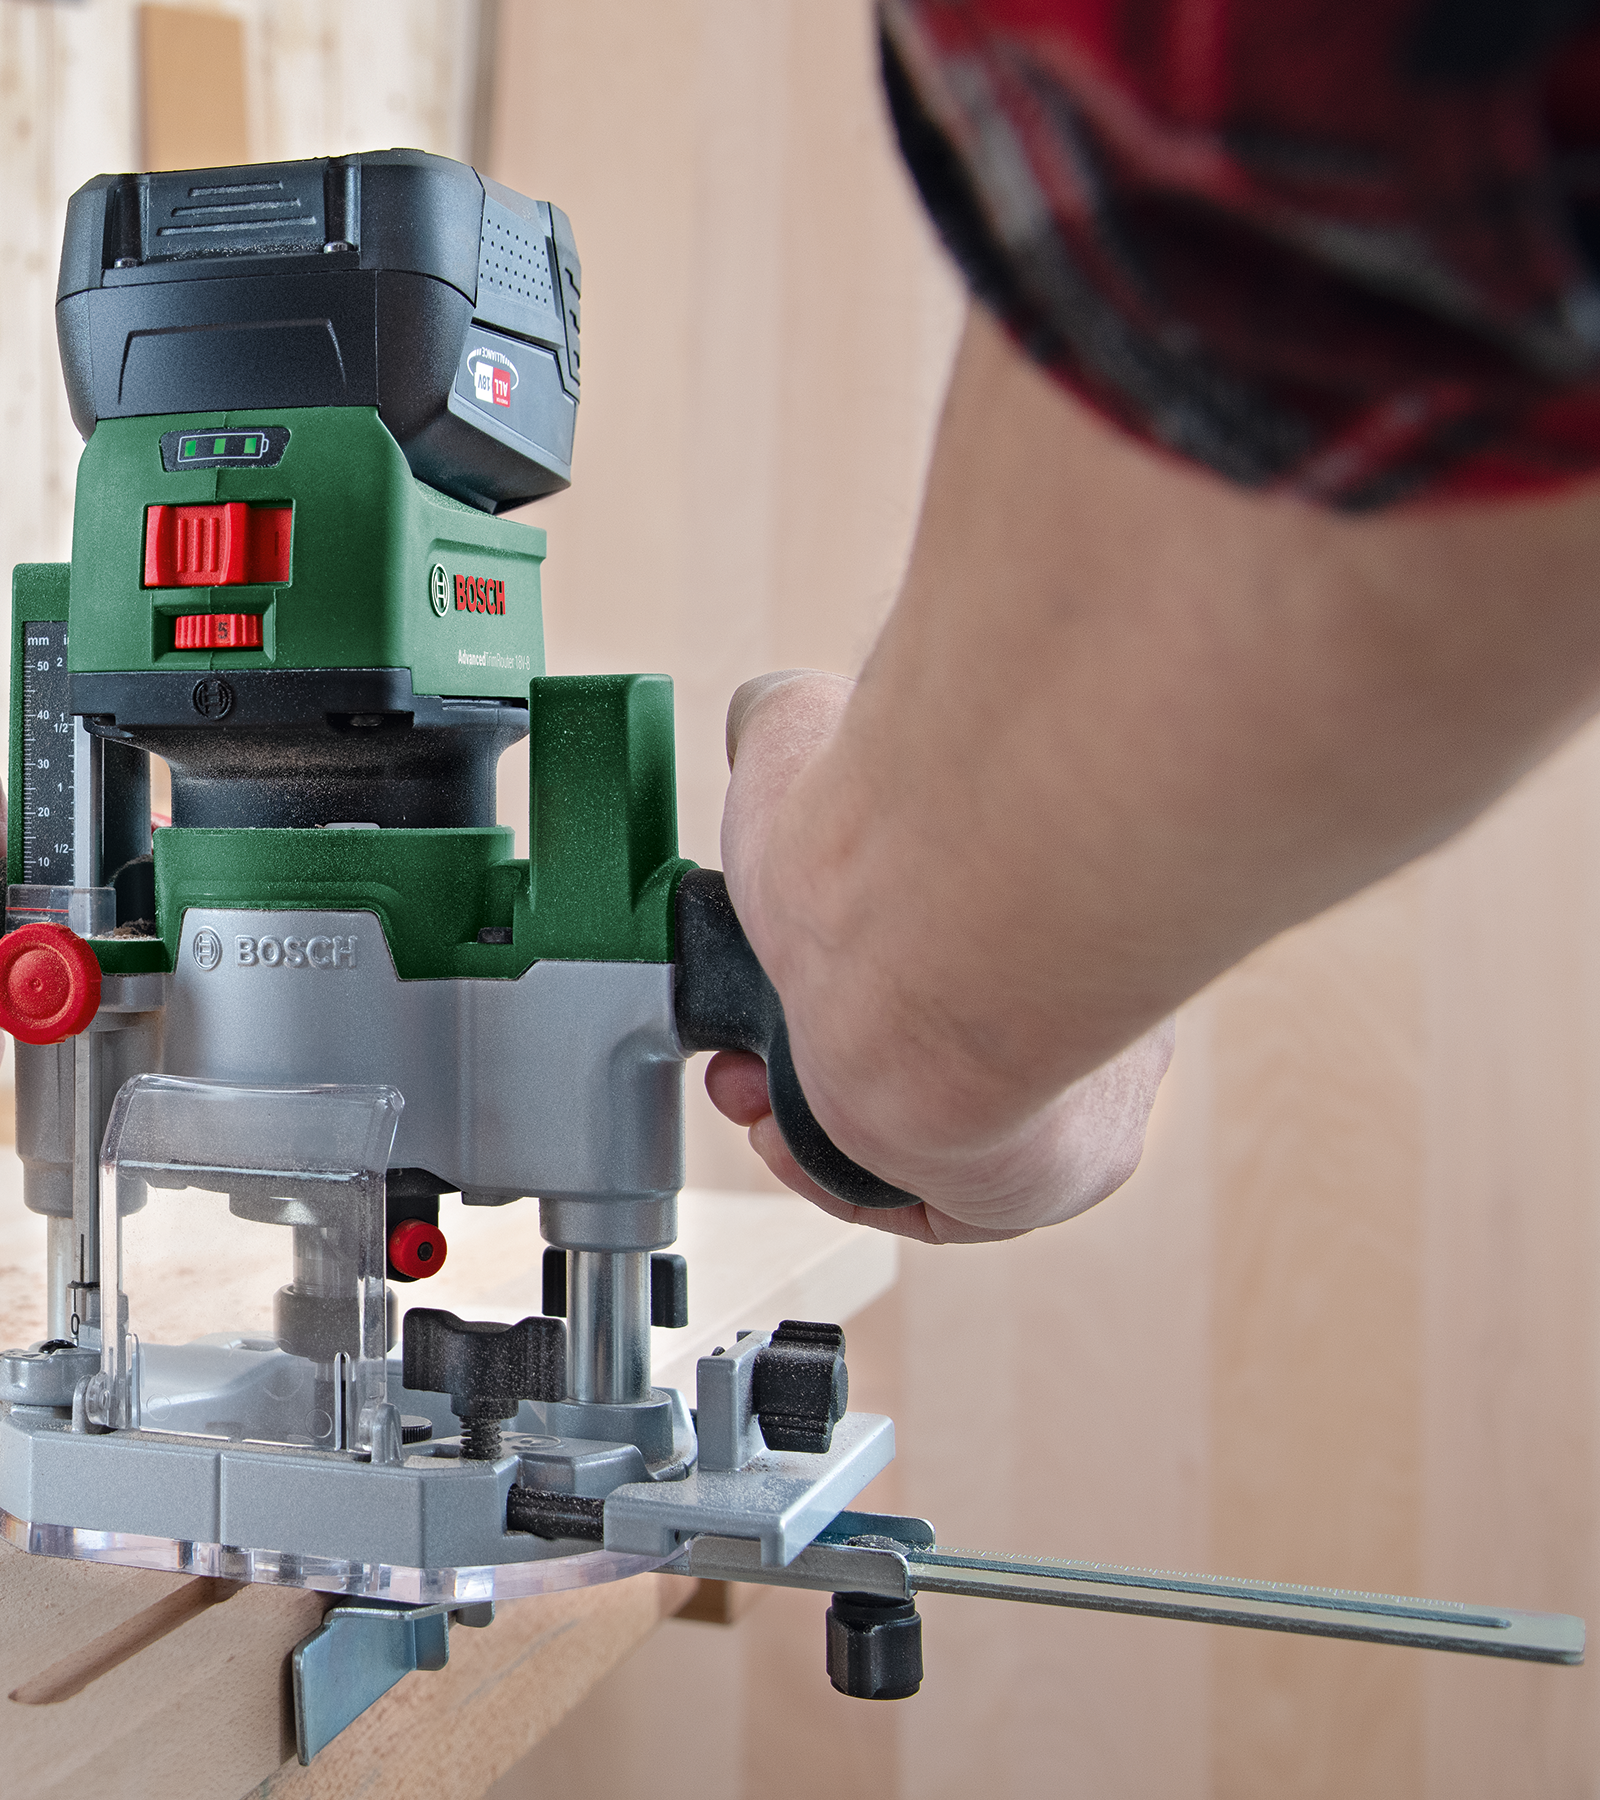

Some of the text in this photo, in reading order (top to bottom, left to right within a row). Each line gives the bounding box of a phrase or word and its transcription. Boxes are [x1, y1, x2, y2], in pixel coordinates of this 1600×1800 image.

[478, 373, 490, 391] 18V
[494, 378, 508, 397] ALL
[454, 574, 506, 615] BOSCH
[218, 622, 228, 639] 5
[27, 637, 49, 645] mm
[37, 661, 49, 671] 50
[57, 657, 63, 667] 2
[37, 710, 49, 720] 40
[60, 713, 64, 722] 1
[53, 723, 68, 733] 1/2
[38, 759, 49, 769] 30
[58, 783, 62, 792] 1
[38, 807, 50, 817] 20
[54, 844, 69, 854] 1/2
[39, 857, 50, 867] 10
[235, 934, 357, 969] BOSCH
